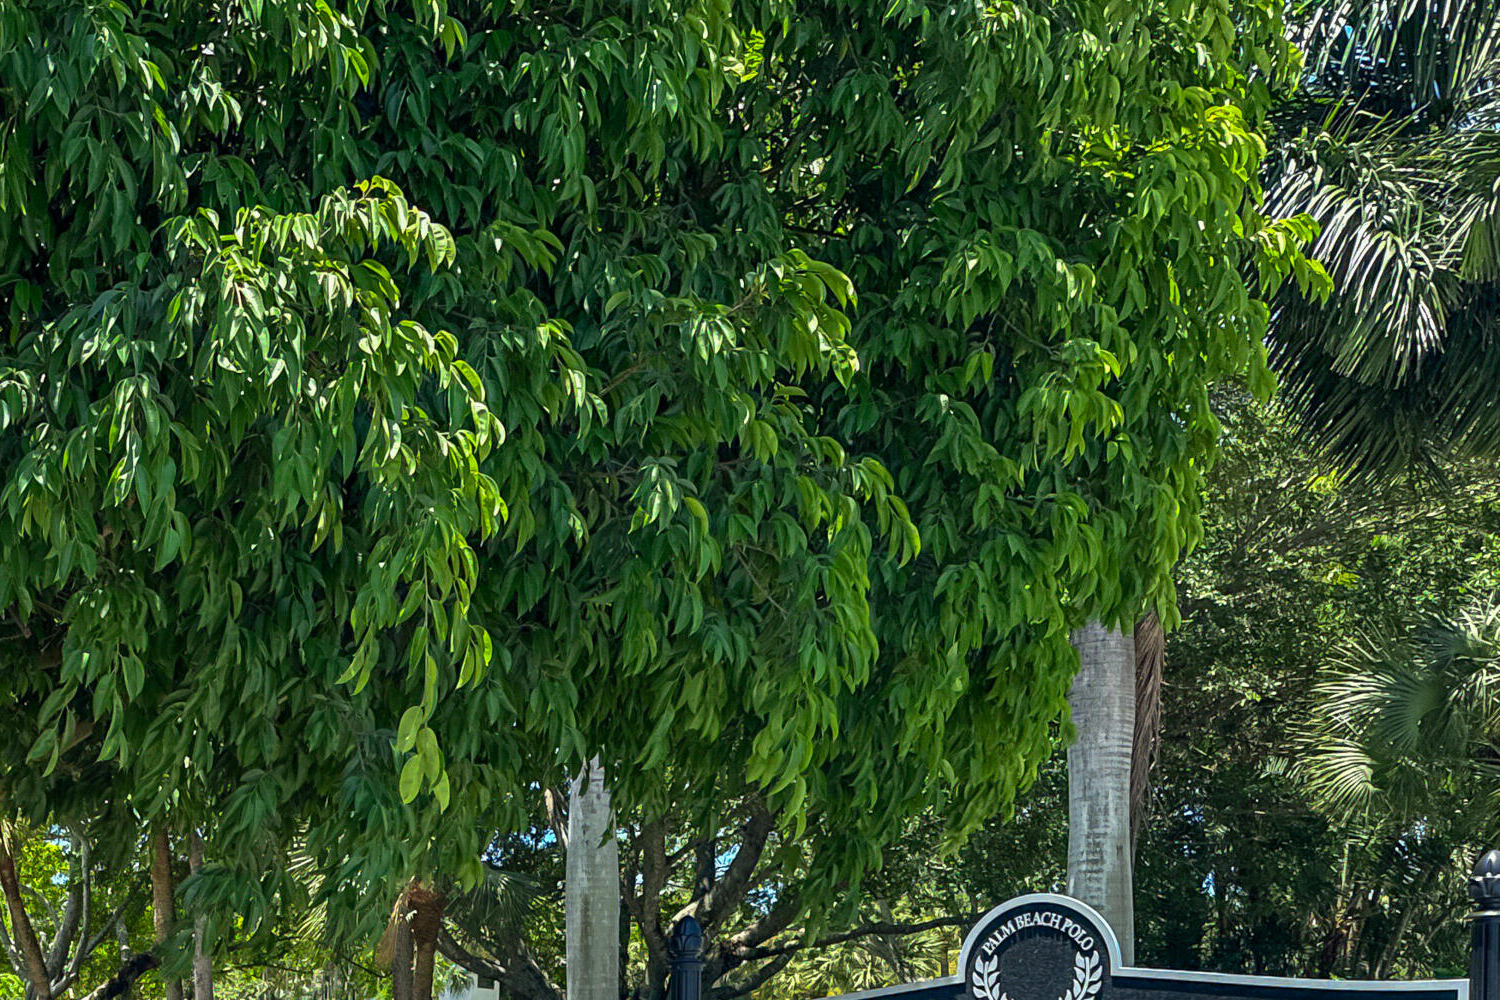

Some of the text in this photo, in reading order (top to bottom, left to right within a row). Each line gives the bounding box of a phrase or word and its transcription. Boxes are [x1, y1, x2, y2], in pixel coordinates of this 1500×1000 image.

[981, 912, 1094, 955] PALM BEACH POLO
